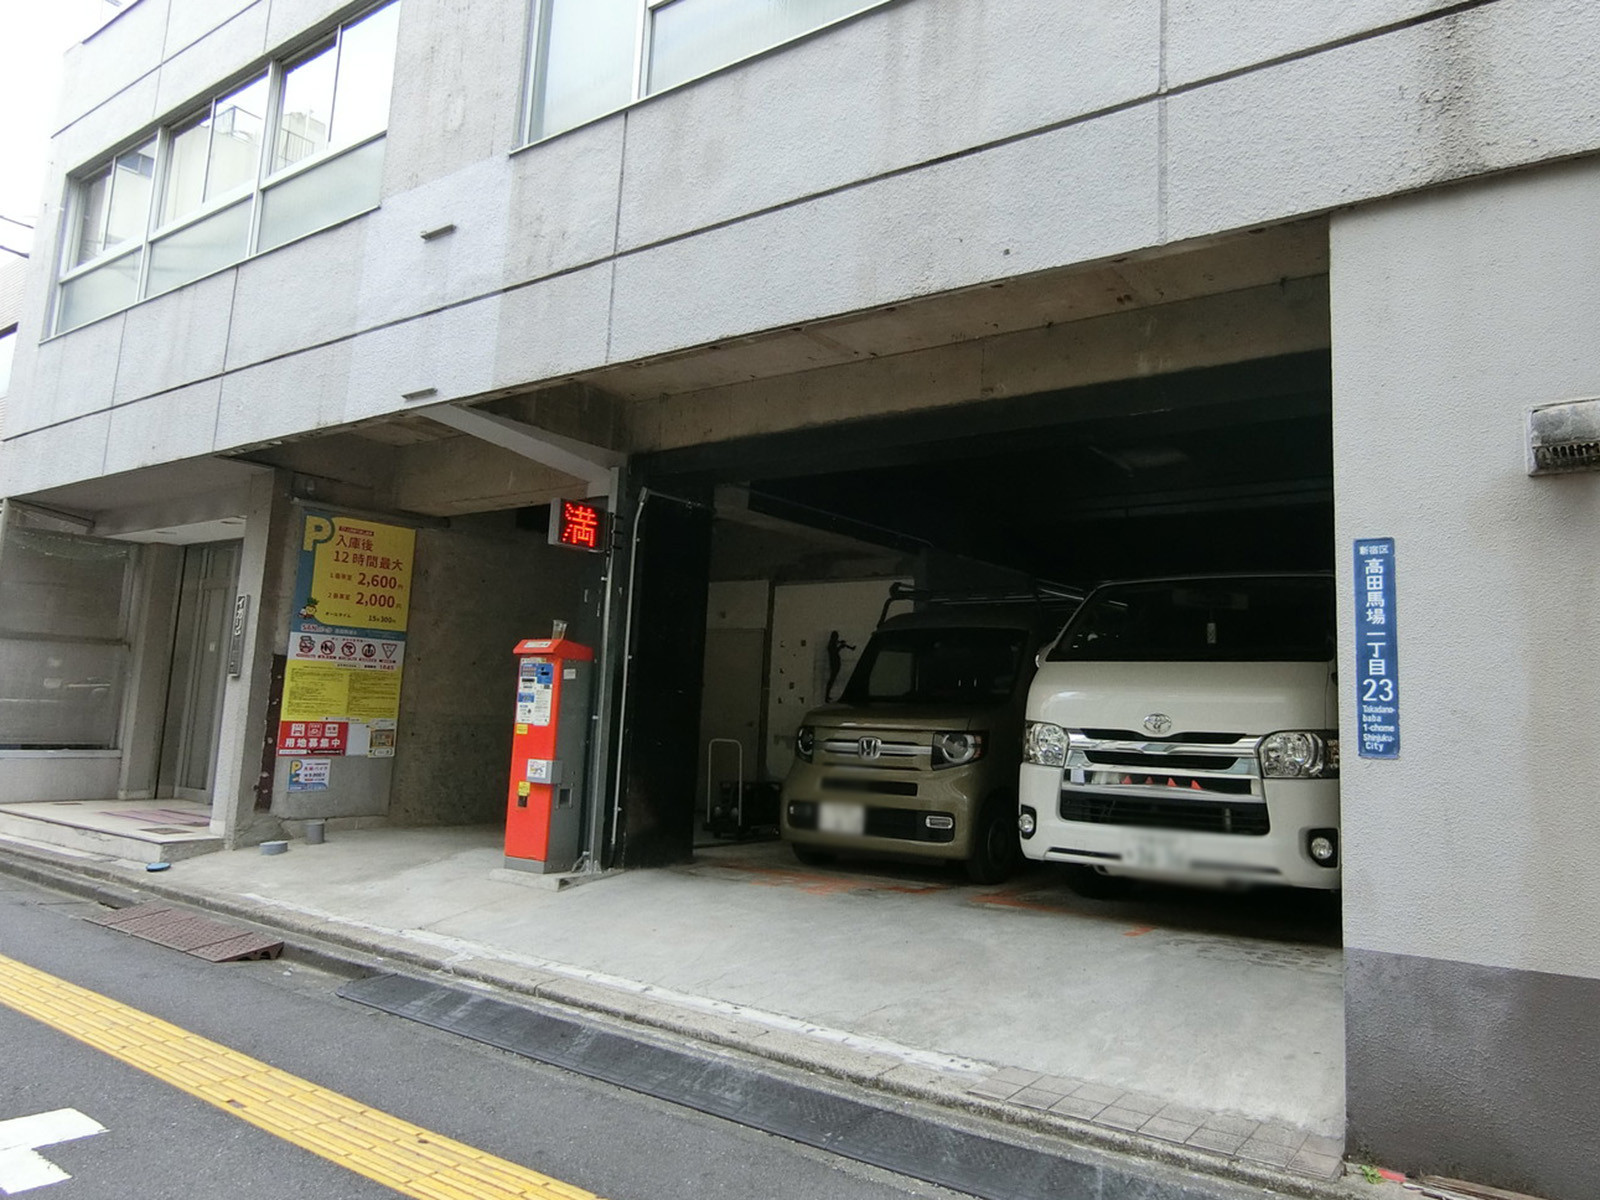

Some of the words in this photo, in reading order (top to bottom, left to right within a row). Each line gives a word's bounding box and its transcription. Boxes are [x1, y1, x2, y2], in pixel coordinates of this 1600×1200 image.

[562, 503, 598, 548] 満
[303, 515, 333, 552] P
[336, 535, 374, 552] 入庫後
[1359, 545, 1389, 555] 新宿区
[1362, 678, 1394, 702] 23
[1362, 714, 1382, 723] baba
[1362, 724, 1395, 732] 1-chome
[285, 738, 341, 748] 用地募集中
[1365, 742, 1384, 752] City
